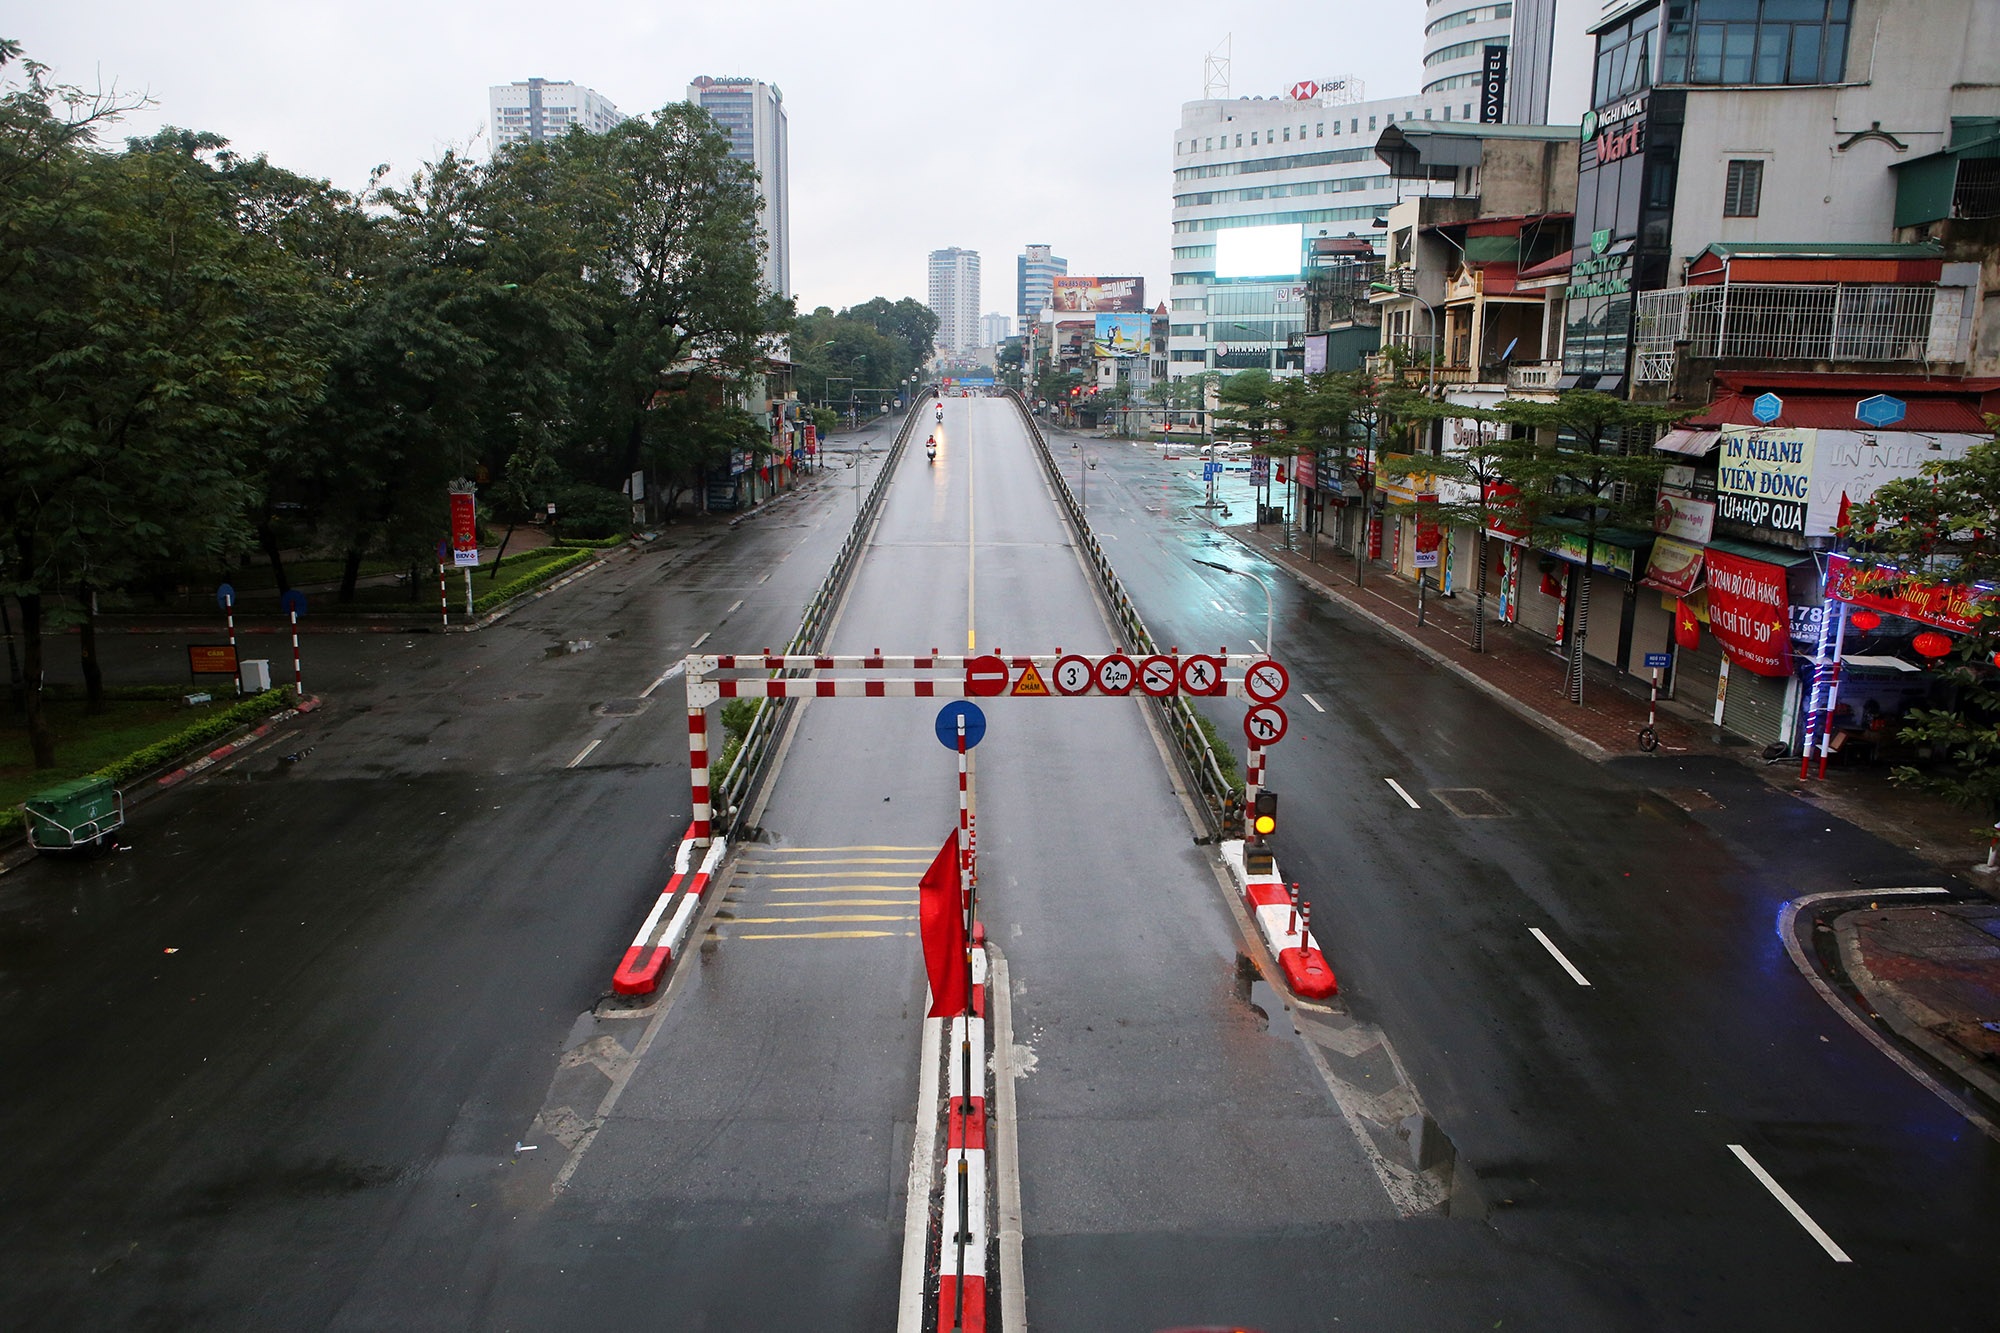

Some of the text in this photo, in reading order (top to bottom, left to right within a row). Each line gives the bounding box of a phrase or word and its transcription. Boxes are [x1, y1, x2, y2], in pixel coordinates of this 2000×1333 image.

[1321, 80, 1346, 92] HSBC
[1598, 98, 1642, 128] NGHI NGA
[1596, 121, 1640, 165] Mart
[1727, 436, 1804, 463] IN NHANH
[1759, 466, 1808, 498] ĐÔNG
[1717, 492, 1803, 531] TÚI+HỘP QUÀ
[1788, 605, 1823, 622] 178
[1105, 666, 1128, 684] 2,2m
[1765, 657, 1780, 666] 995
